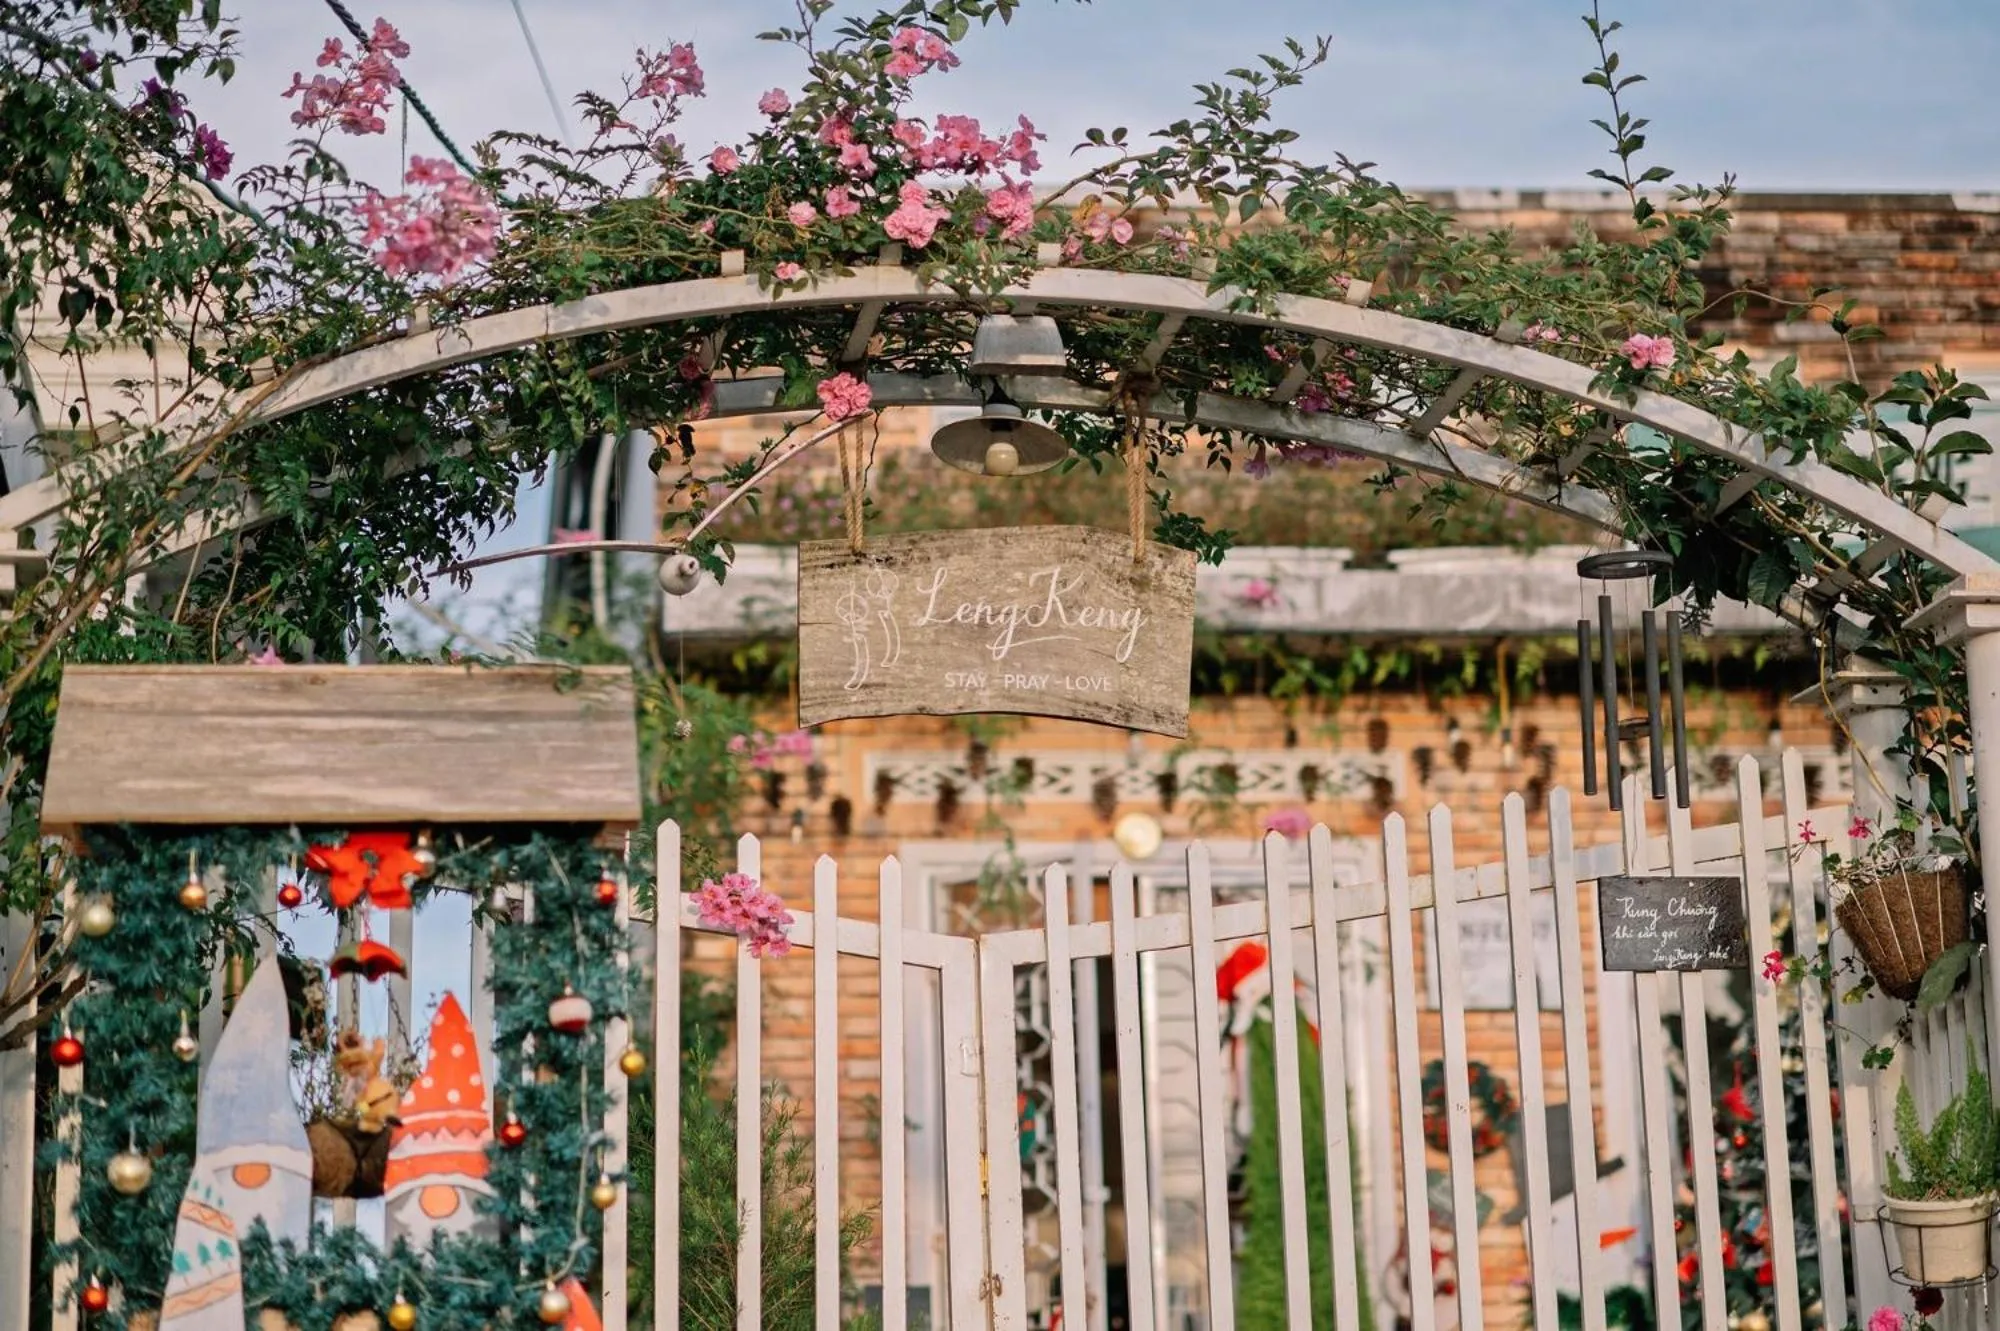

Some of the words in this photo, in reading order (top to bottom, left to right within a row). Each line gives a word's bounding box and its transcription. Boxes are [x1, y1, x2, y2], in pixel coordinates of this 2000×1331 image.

[944, 672, 987, 690] STAY
[1003, 673, 1049, 690] PRAY
[1066, 675, 1114, 692] LOVE
